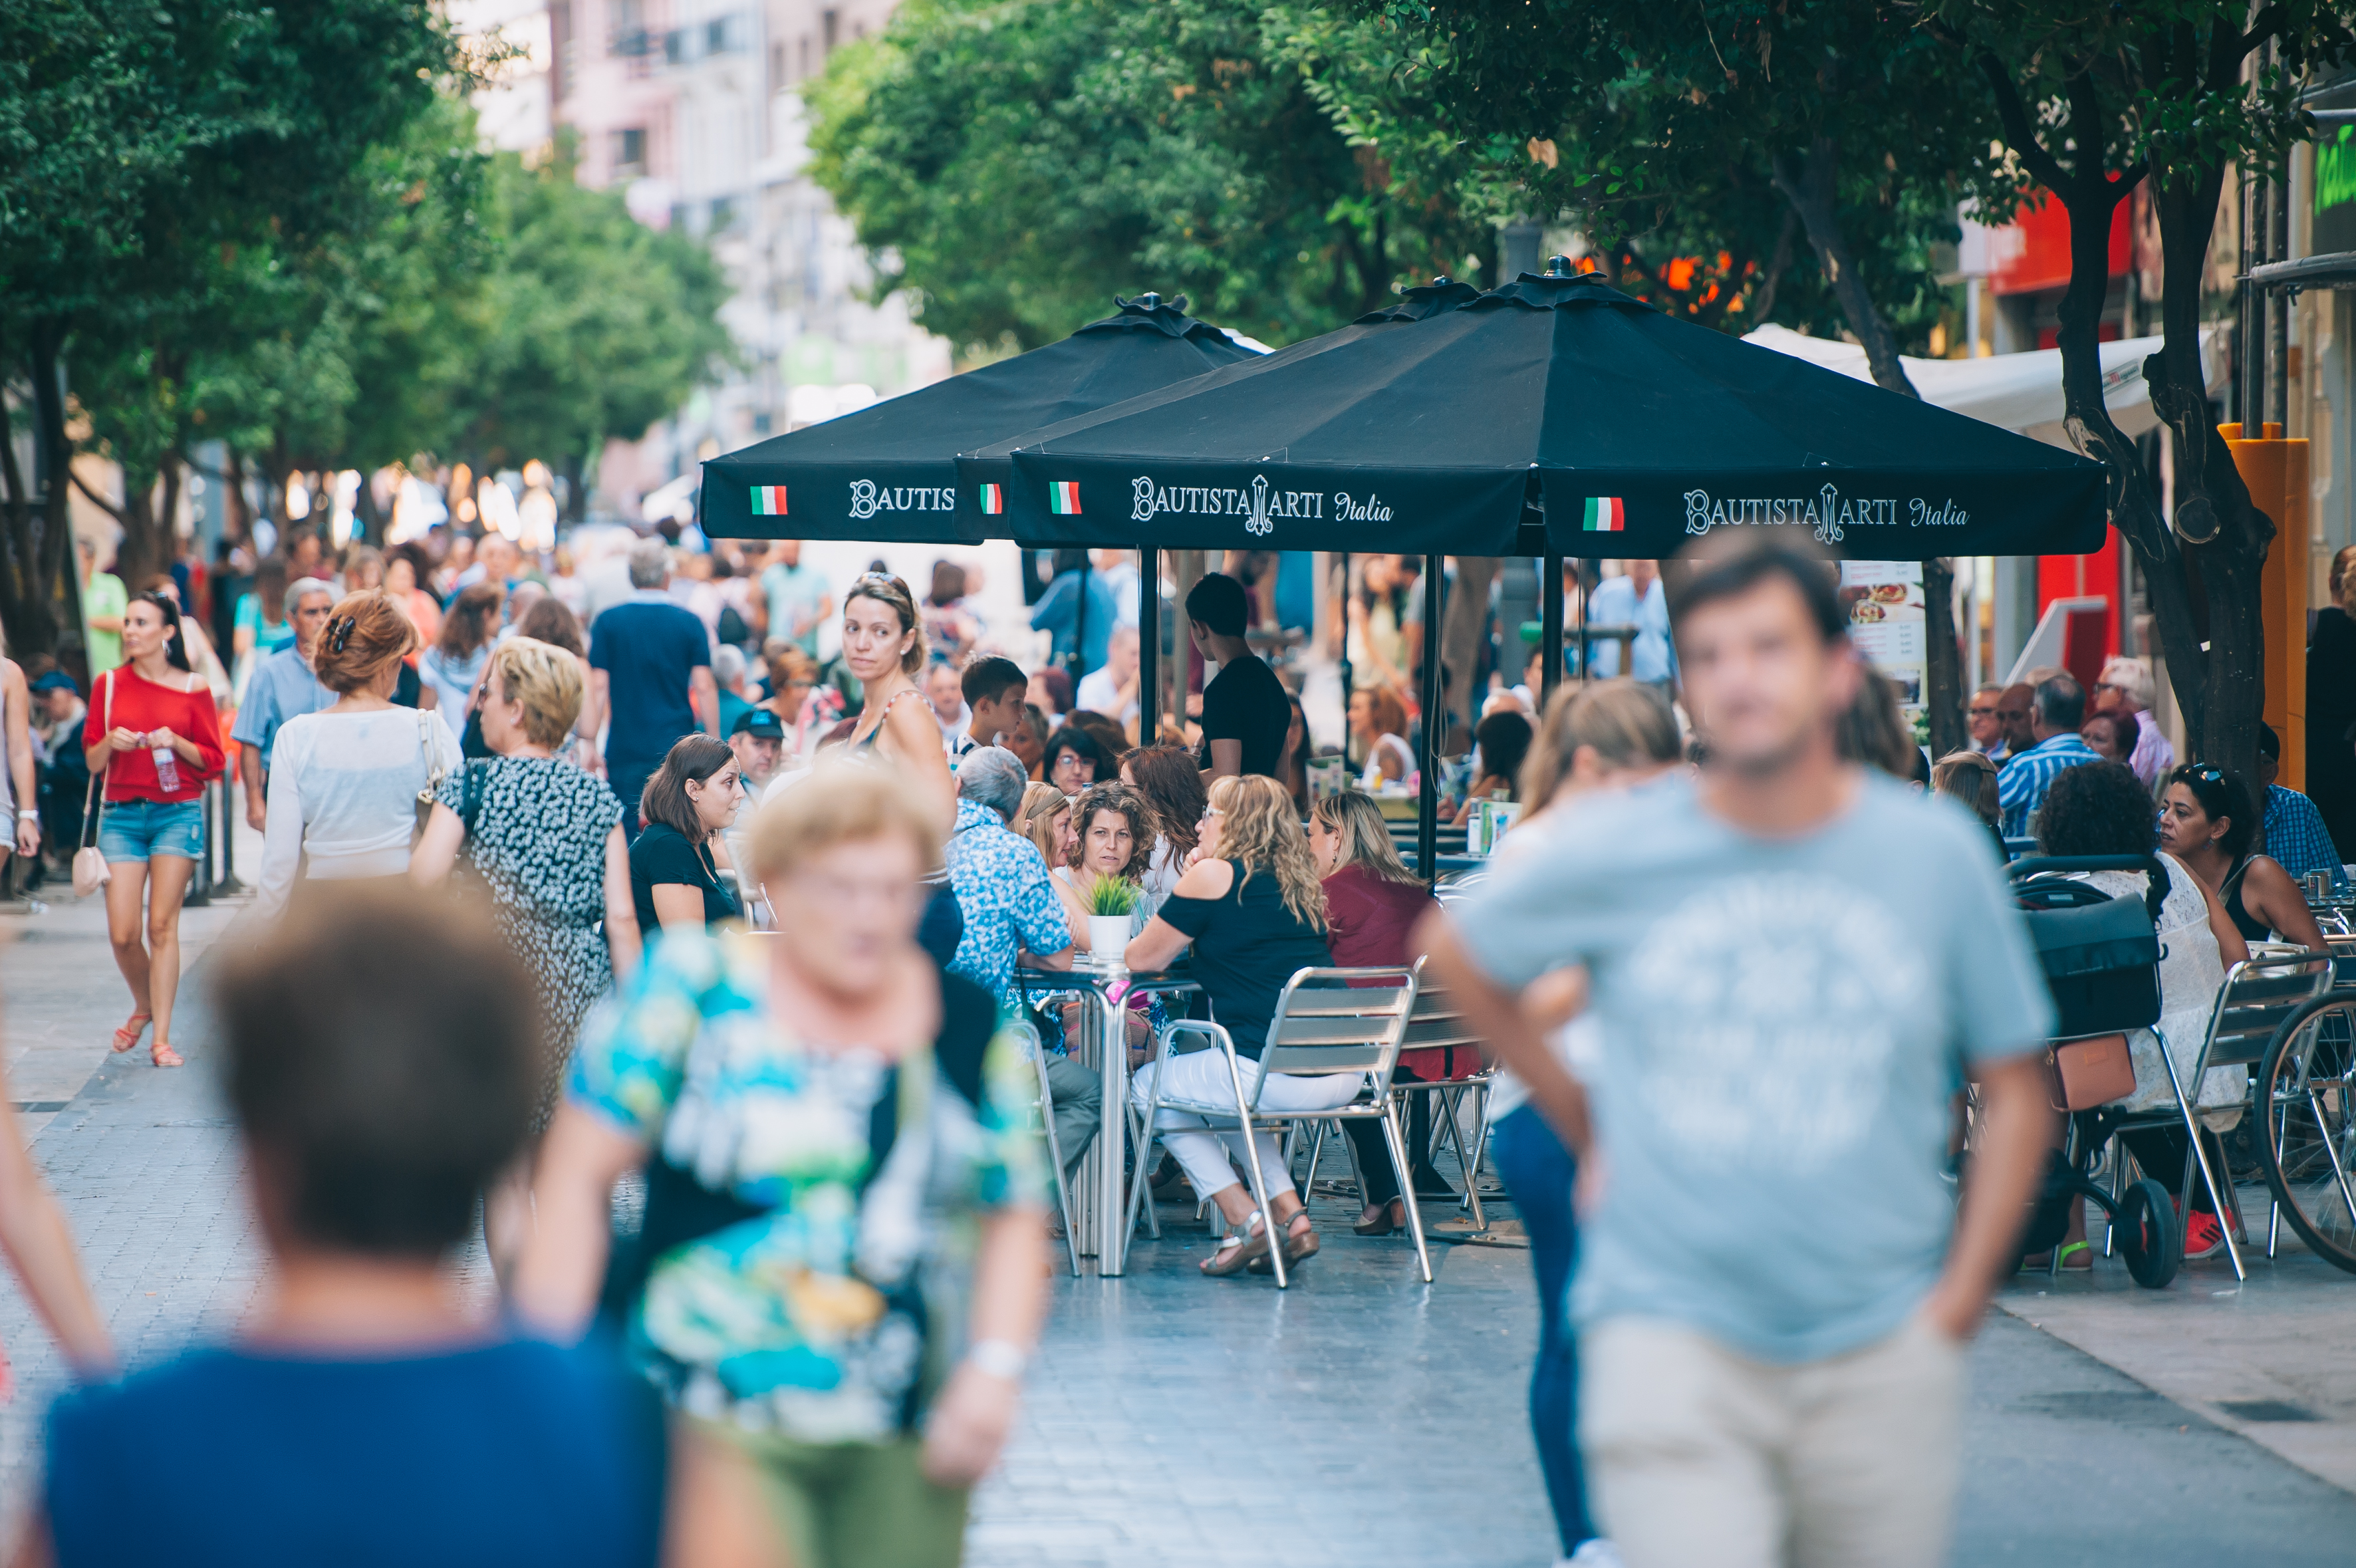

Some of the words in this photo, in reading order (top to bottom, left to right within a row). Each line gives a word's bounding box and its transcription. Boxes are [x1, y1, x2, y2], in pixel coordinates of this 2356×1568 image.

[1131, 476, 1252, 522] BAUTISTA
[1334, 492, 1394, 521] Italia
[1684, 489, 1821, 535] BAUTISTA
[1909, 498, 1970, 527] Italia
